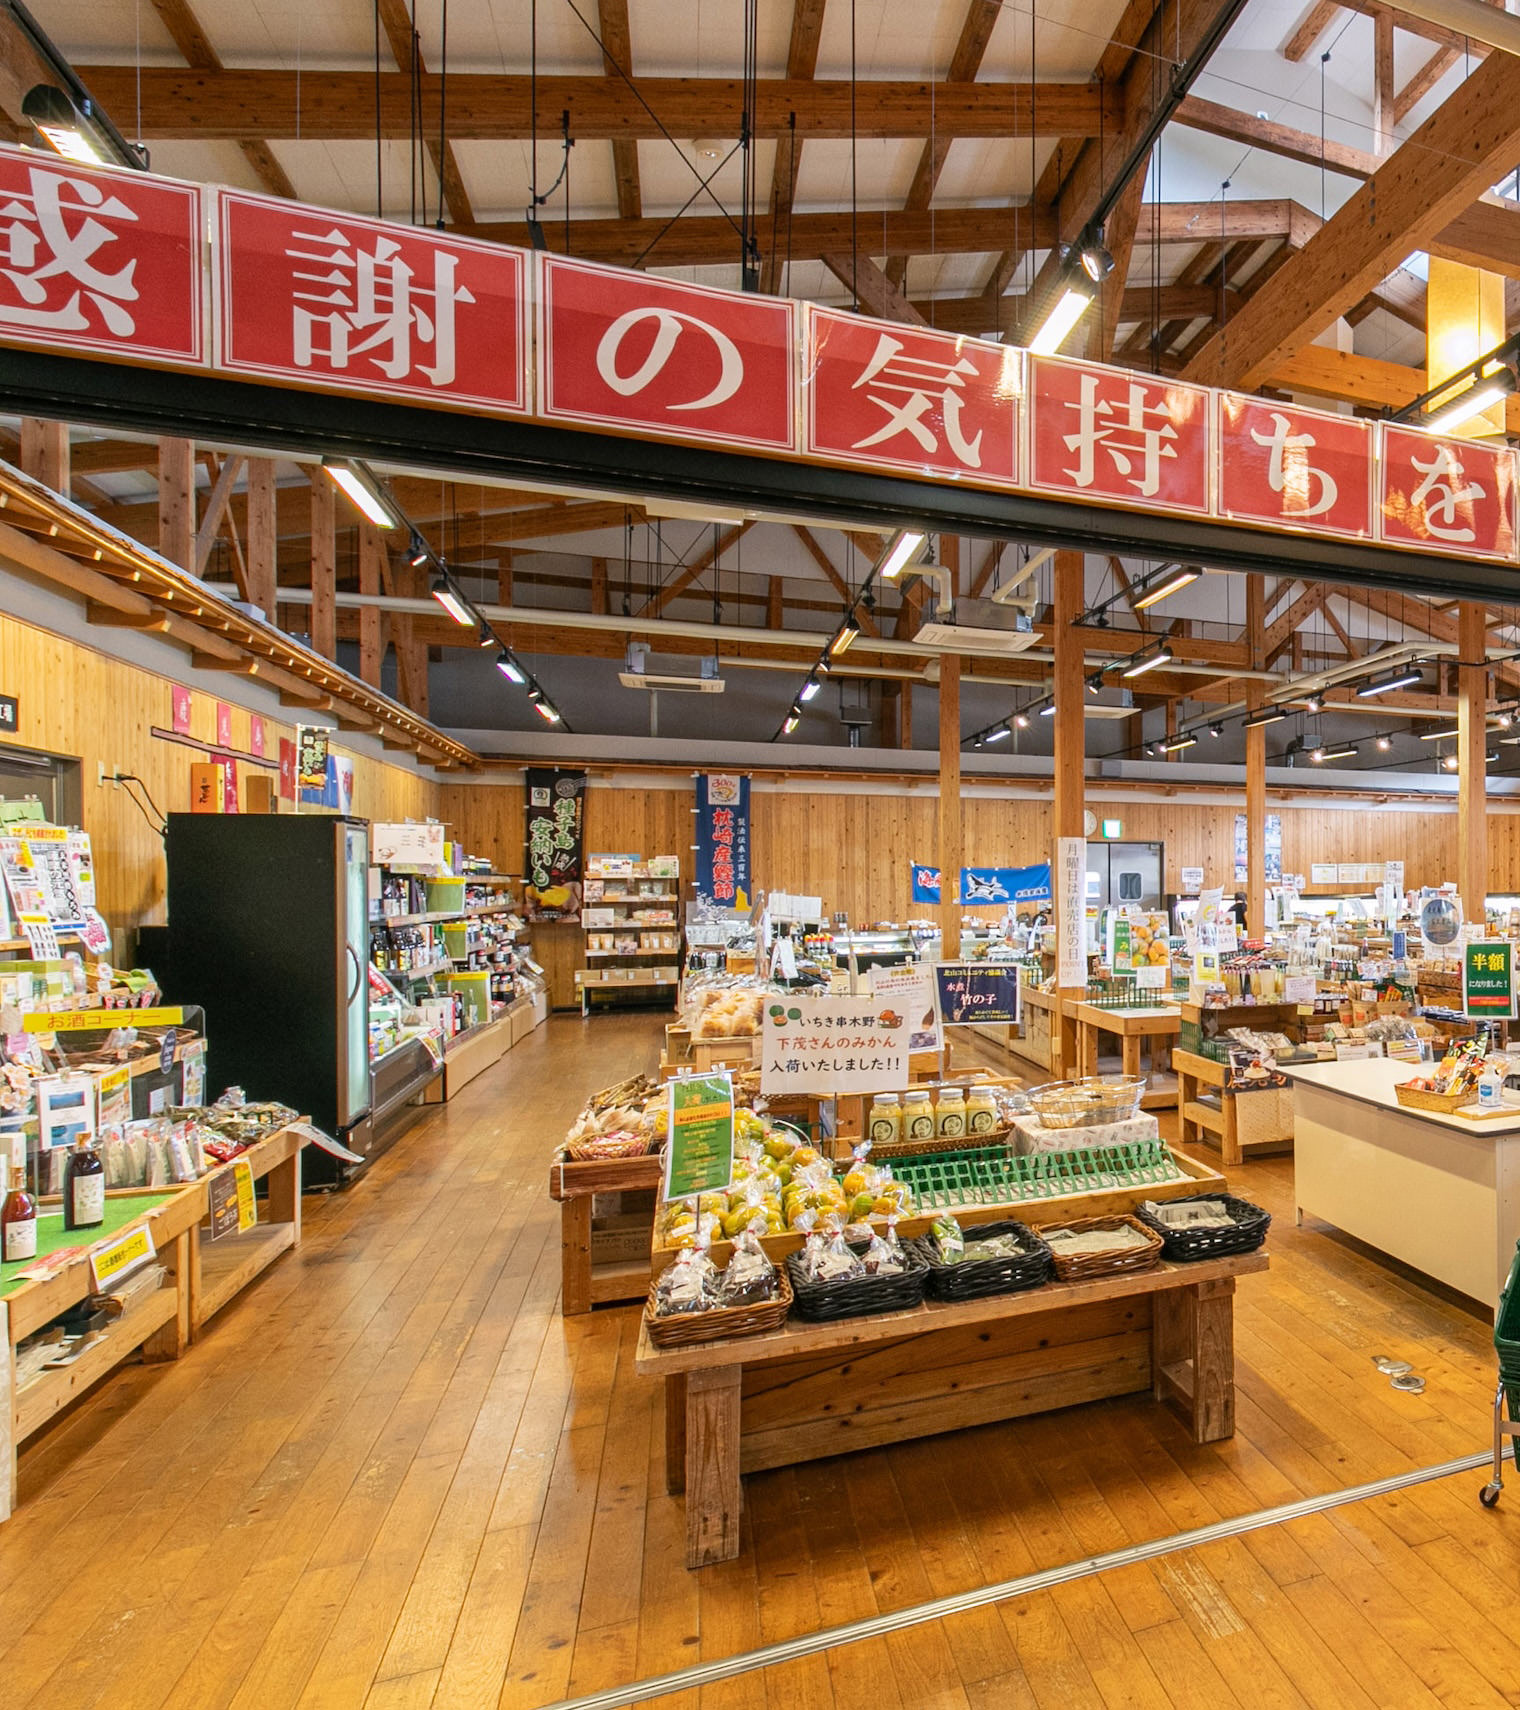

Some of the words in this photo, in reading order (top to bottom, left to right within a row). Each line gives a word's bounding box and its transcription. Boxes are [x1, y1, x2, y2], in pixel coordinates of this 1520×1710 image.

[553, 798, 576, 850] 種子島
[530, 816, 554, 887] 安納いも
[712, 808, 735, 900] 枕崎産鰹節
[1472, 953, 1505, 972] 半額
[960, 993, 997, 1006] 竹の子
[47, 1011, 161, 1029] お酒コーナー
[800, 1015, 876, 1028] いちき串木野
[776, 1036, 897, 1051] 下茂さんのみかん
[769, 1057, 900, 1074] 入荷いたしました!!
